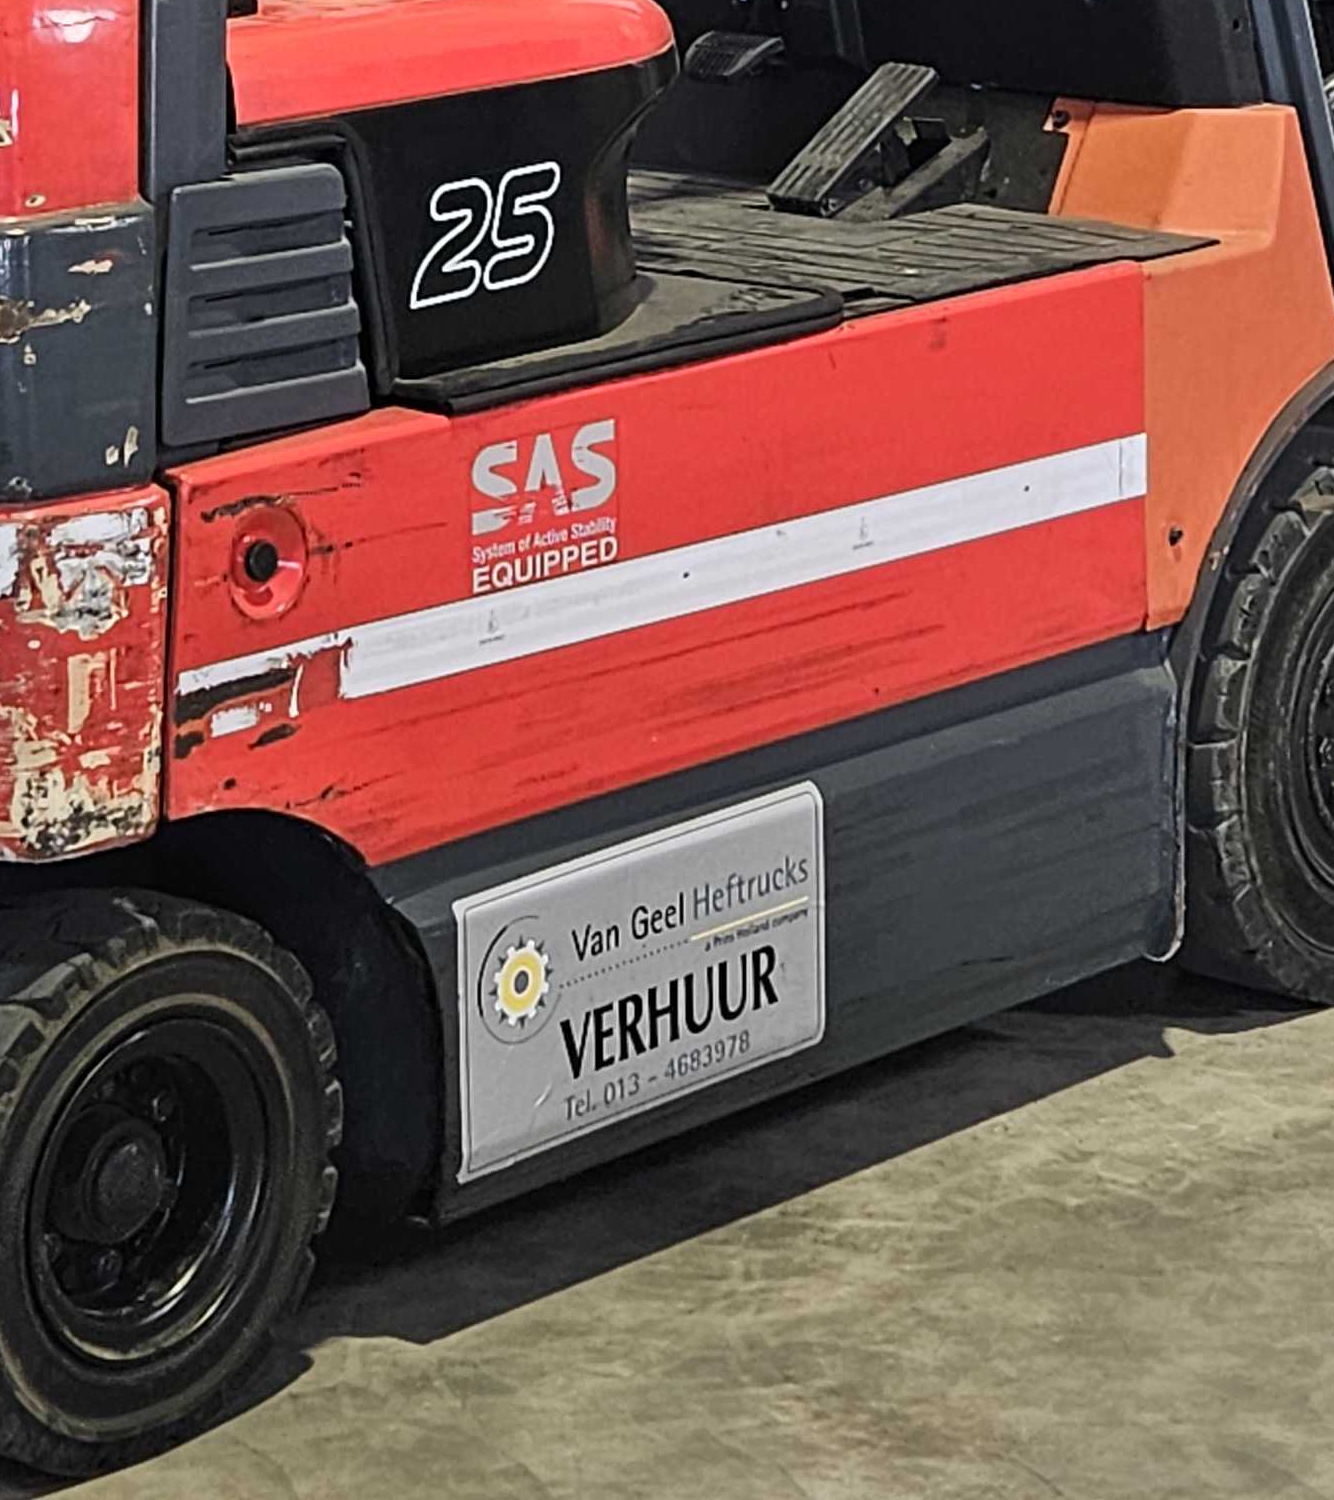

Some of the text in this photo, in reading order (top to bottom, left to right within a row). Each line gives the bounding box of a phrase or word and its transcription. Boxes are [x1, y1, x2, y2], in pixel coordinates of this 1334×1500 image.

[410, 161, 560, 310] 25
[471, 418, 616, 535] SAS
[471, 515, 617, 565] System of Active Stability
[472, 536, 618, 595] EQUIPPED
[571, 854, 809, 962] Van Geel Heftrucks
[559, 944, 779, 1080] VERHUUR
[564, 1089, 598, 1121] Tel.
[603, 1071, 641, 1105] 013
[664, 1030, 751, 1081] 4683978
